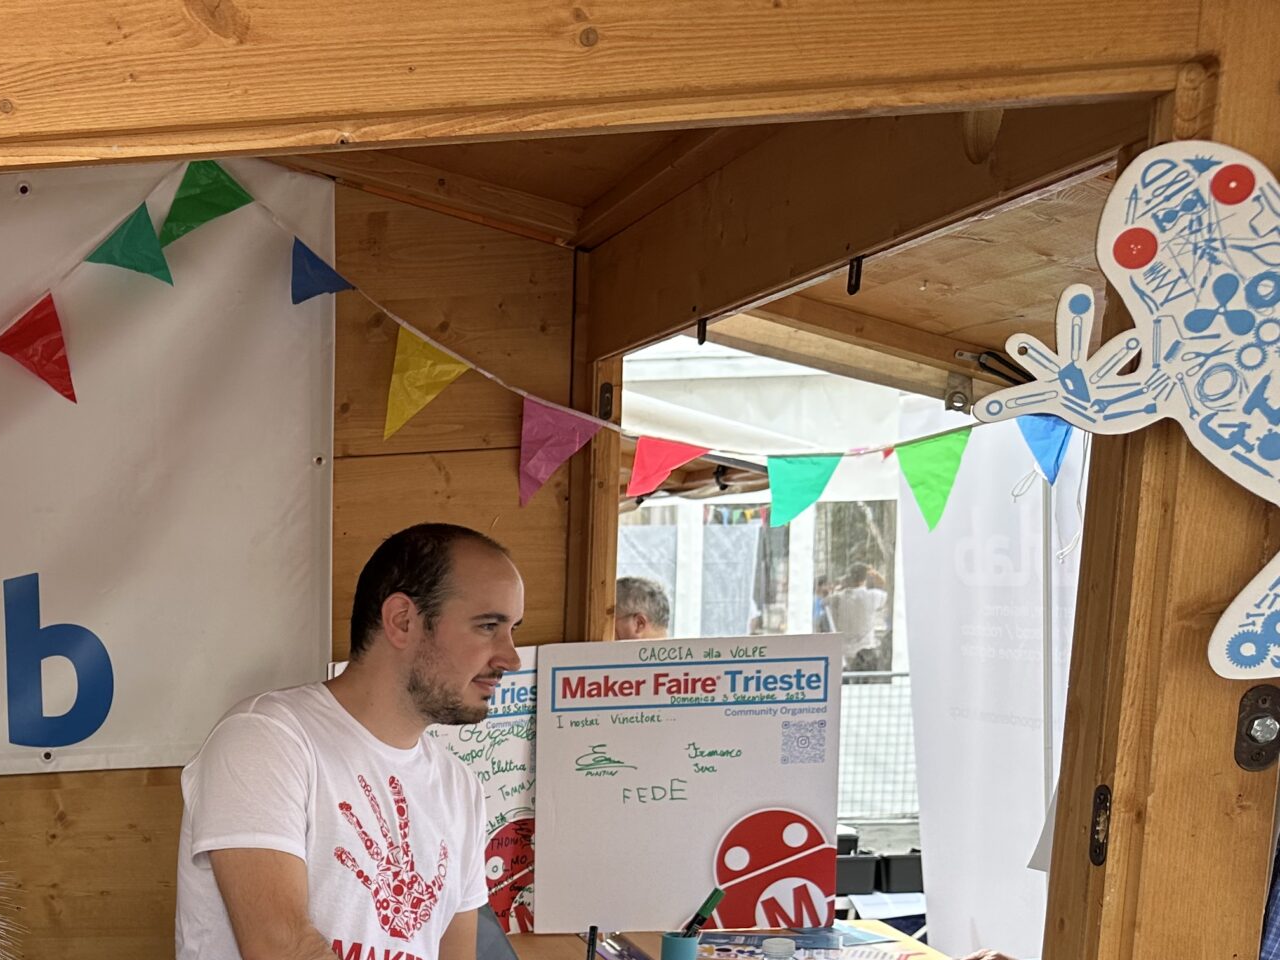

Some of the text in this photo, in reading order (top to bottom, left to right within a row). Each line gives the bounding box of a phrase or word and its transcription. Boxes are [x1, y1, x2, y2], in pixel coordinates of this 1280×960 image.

[638, 646, 768, 661] CACCIA alla VOLPE
[489, 682, 537, 706] Tries
[562, 669, 822, 699] Maker Faire Trieste
[724, 706, 828, 717] Community Organized
[623, 778, 688, 804] FEDE
